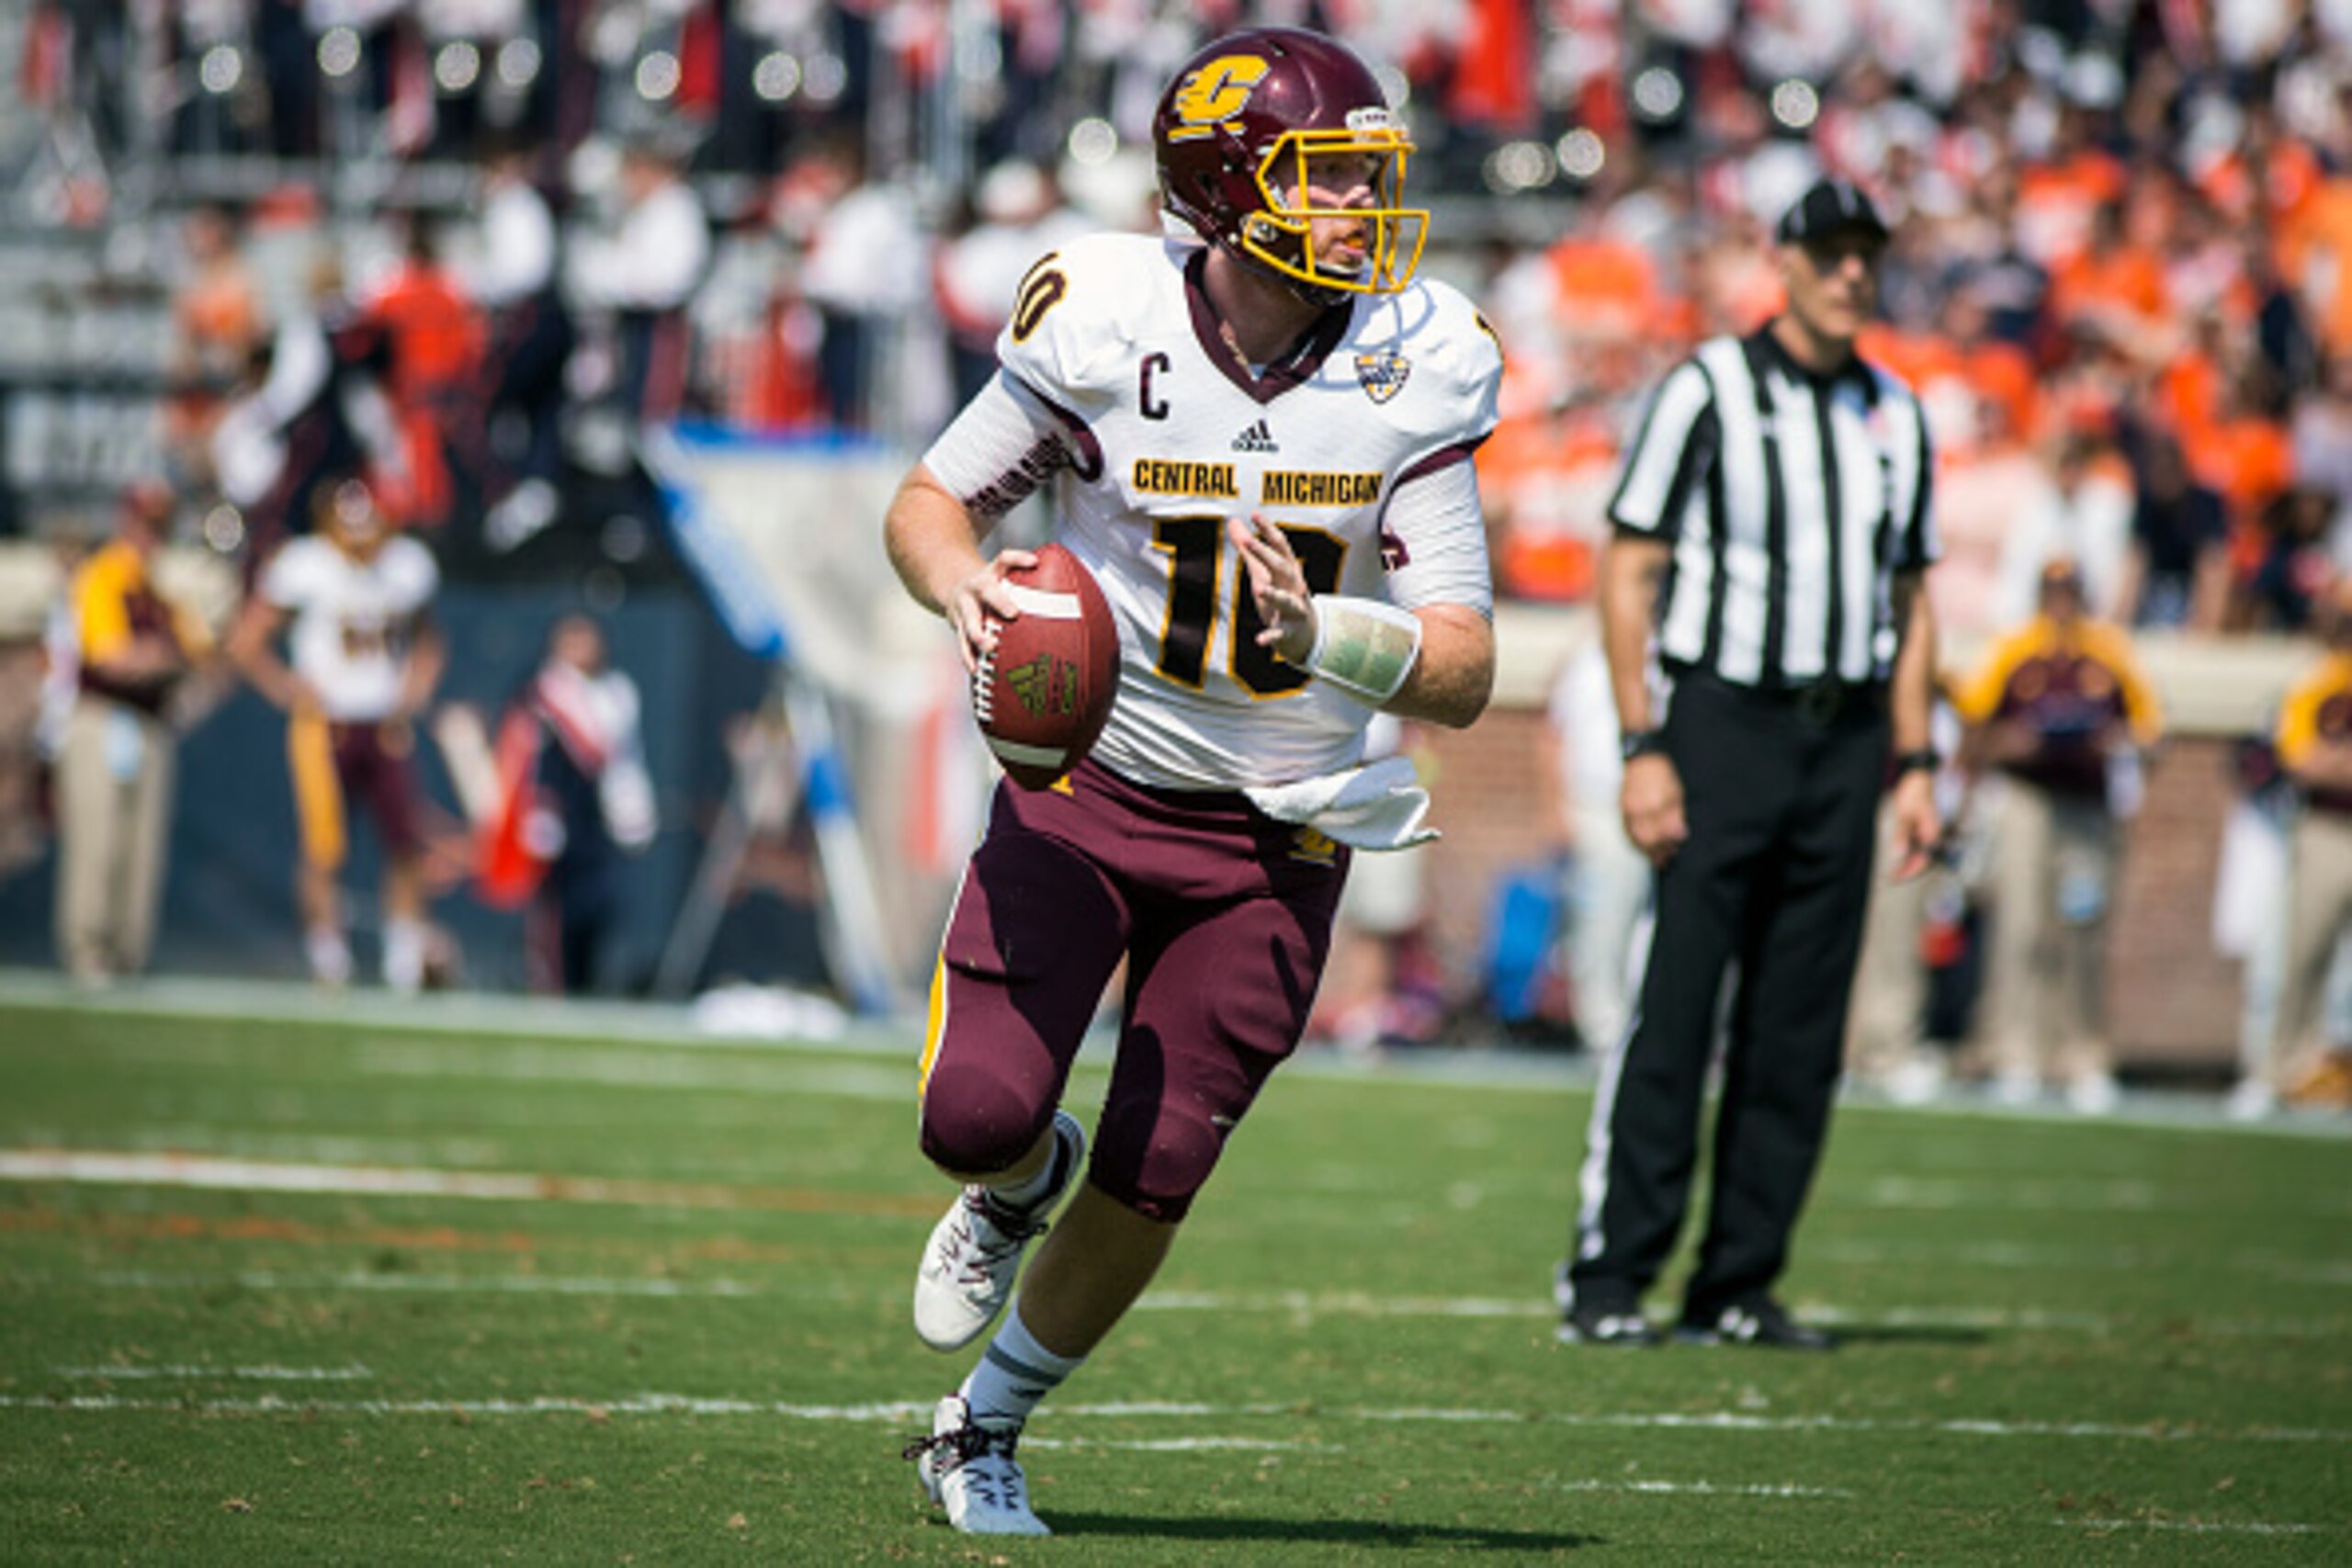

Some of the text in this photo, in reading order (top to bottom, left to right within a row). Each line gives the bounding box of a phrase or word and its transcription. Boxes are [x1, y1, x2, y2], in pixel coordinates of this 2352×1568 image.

[1140, 352, 1170, 420] C
[1132, 458, 1385, 507] CENTRAL MICHIGAN
[1151, 515, 1350, 701] 10
